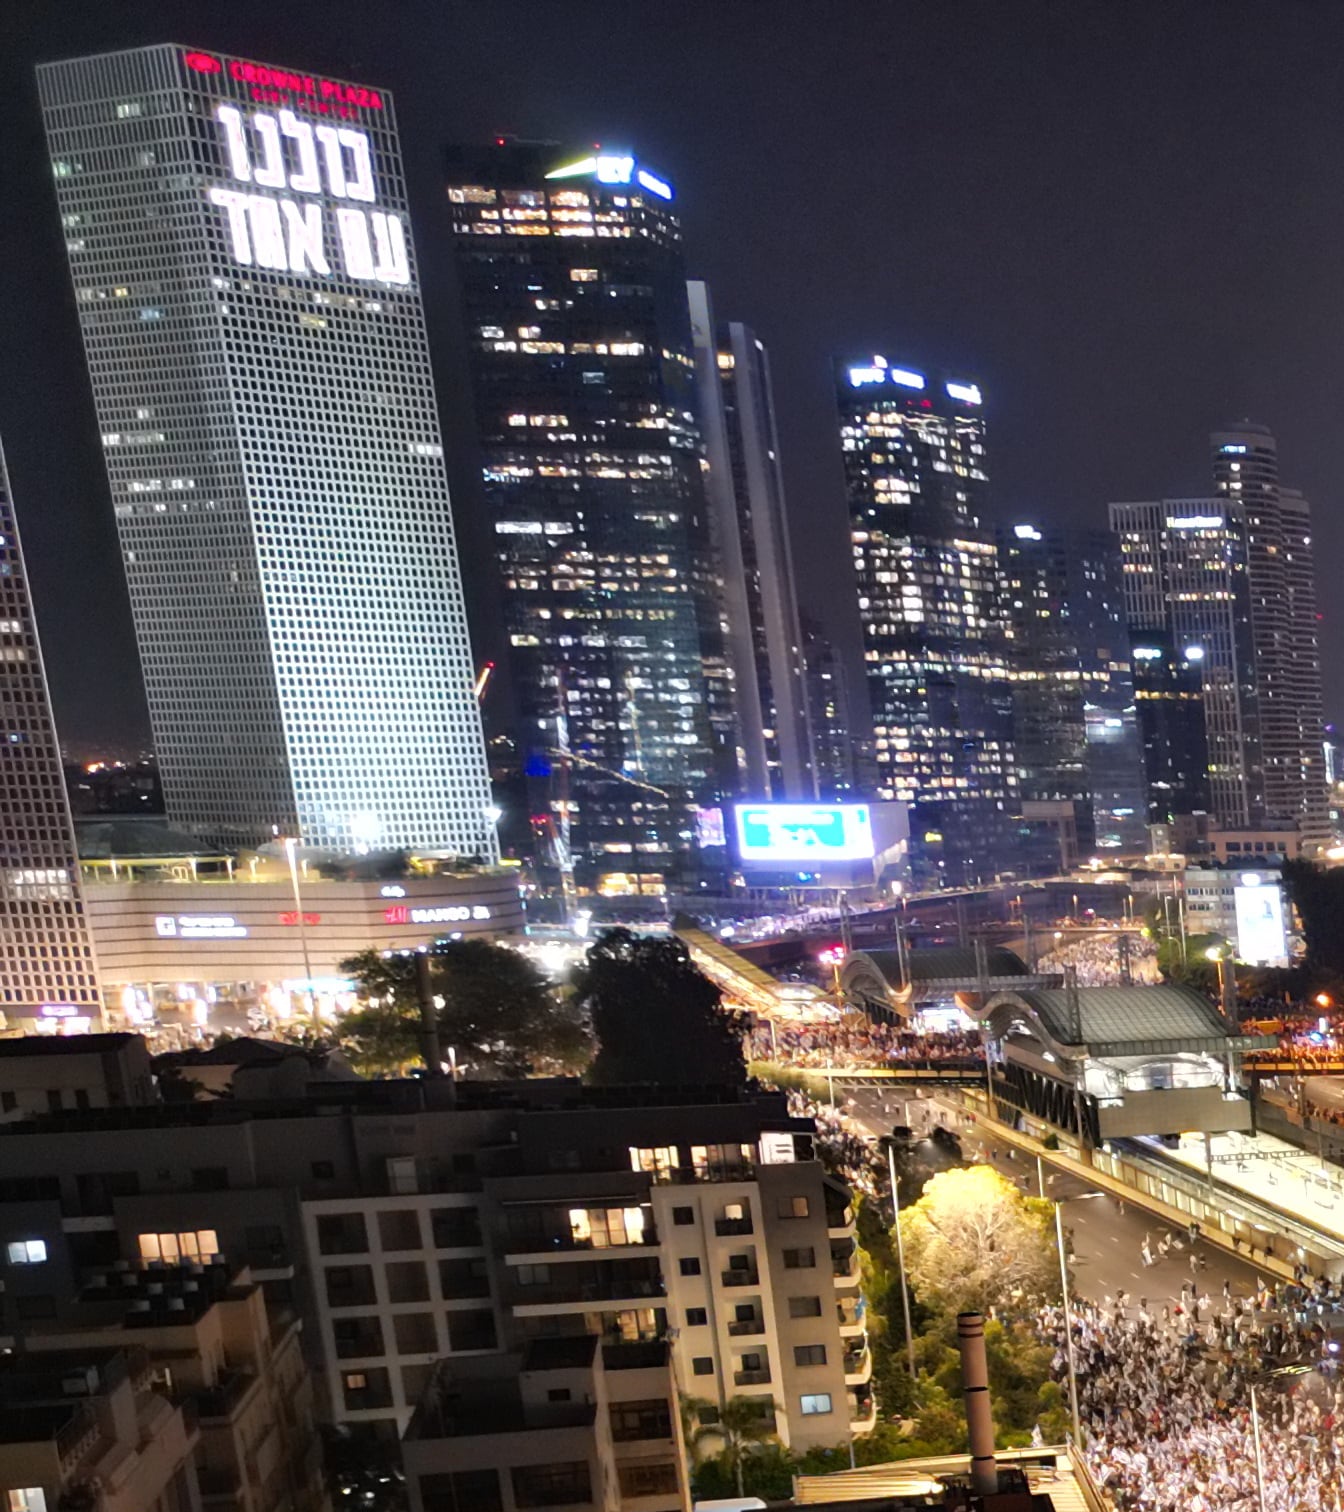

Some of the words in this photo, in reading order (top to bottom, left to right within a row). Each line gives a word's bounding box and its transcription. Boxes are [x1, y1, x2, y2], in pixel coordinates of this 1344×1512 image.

[229, 60, 315, 96] CROWNE
[319, 78, 383, 110] PLAZA
[217, 105, 375, 202] כולנו
[210, 188, 332, 275] אחד
[337, 208, 410, 284] עם
